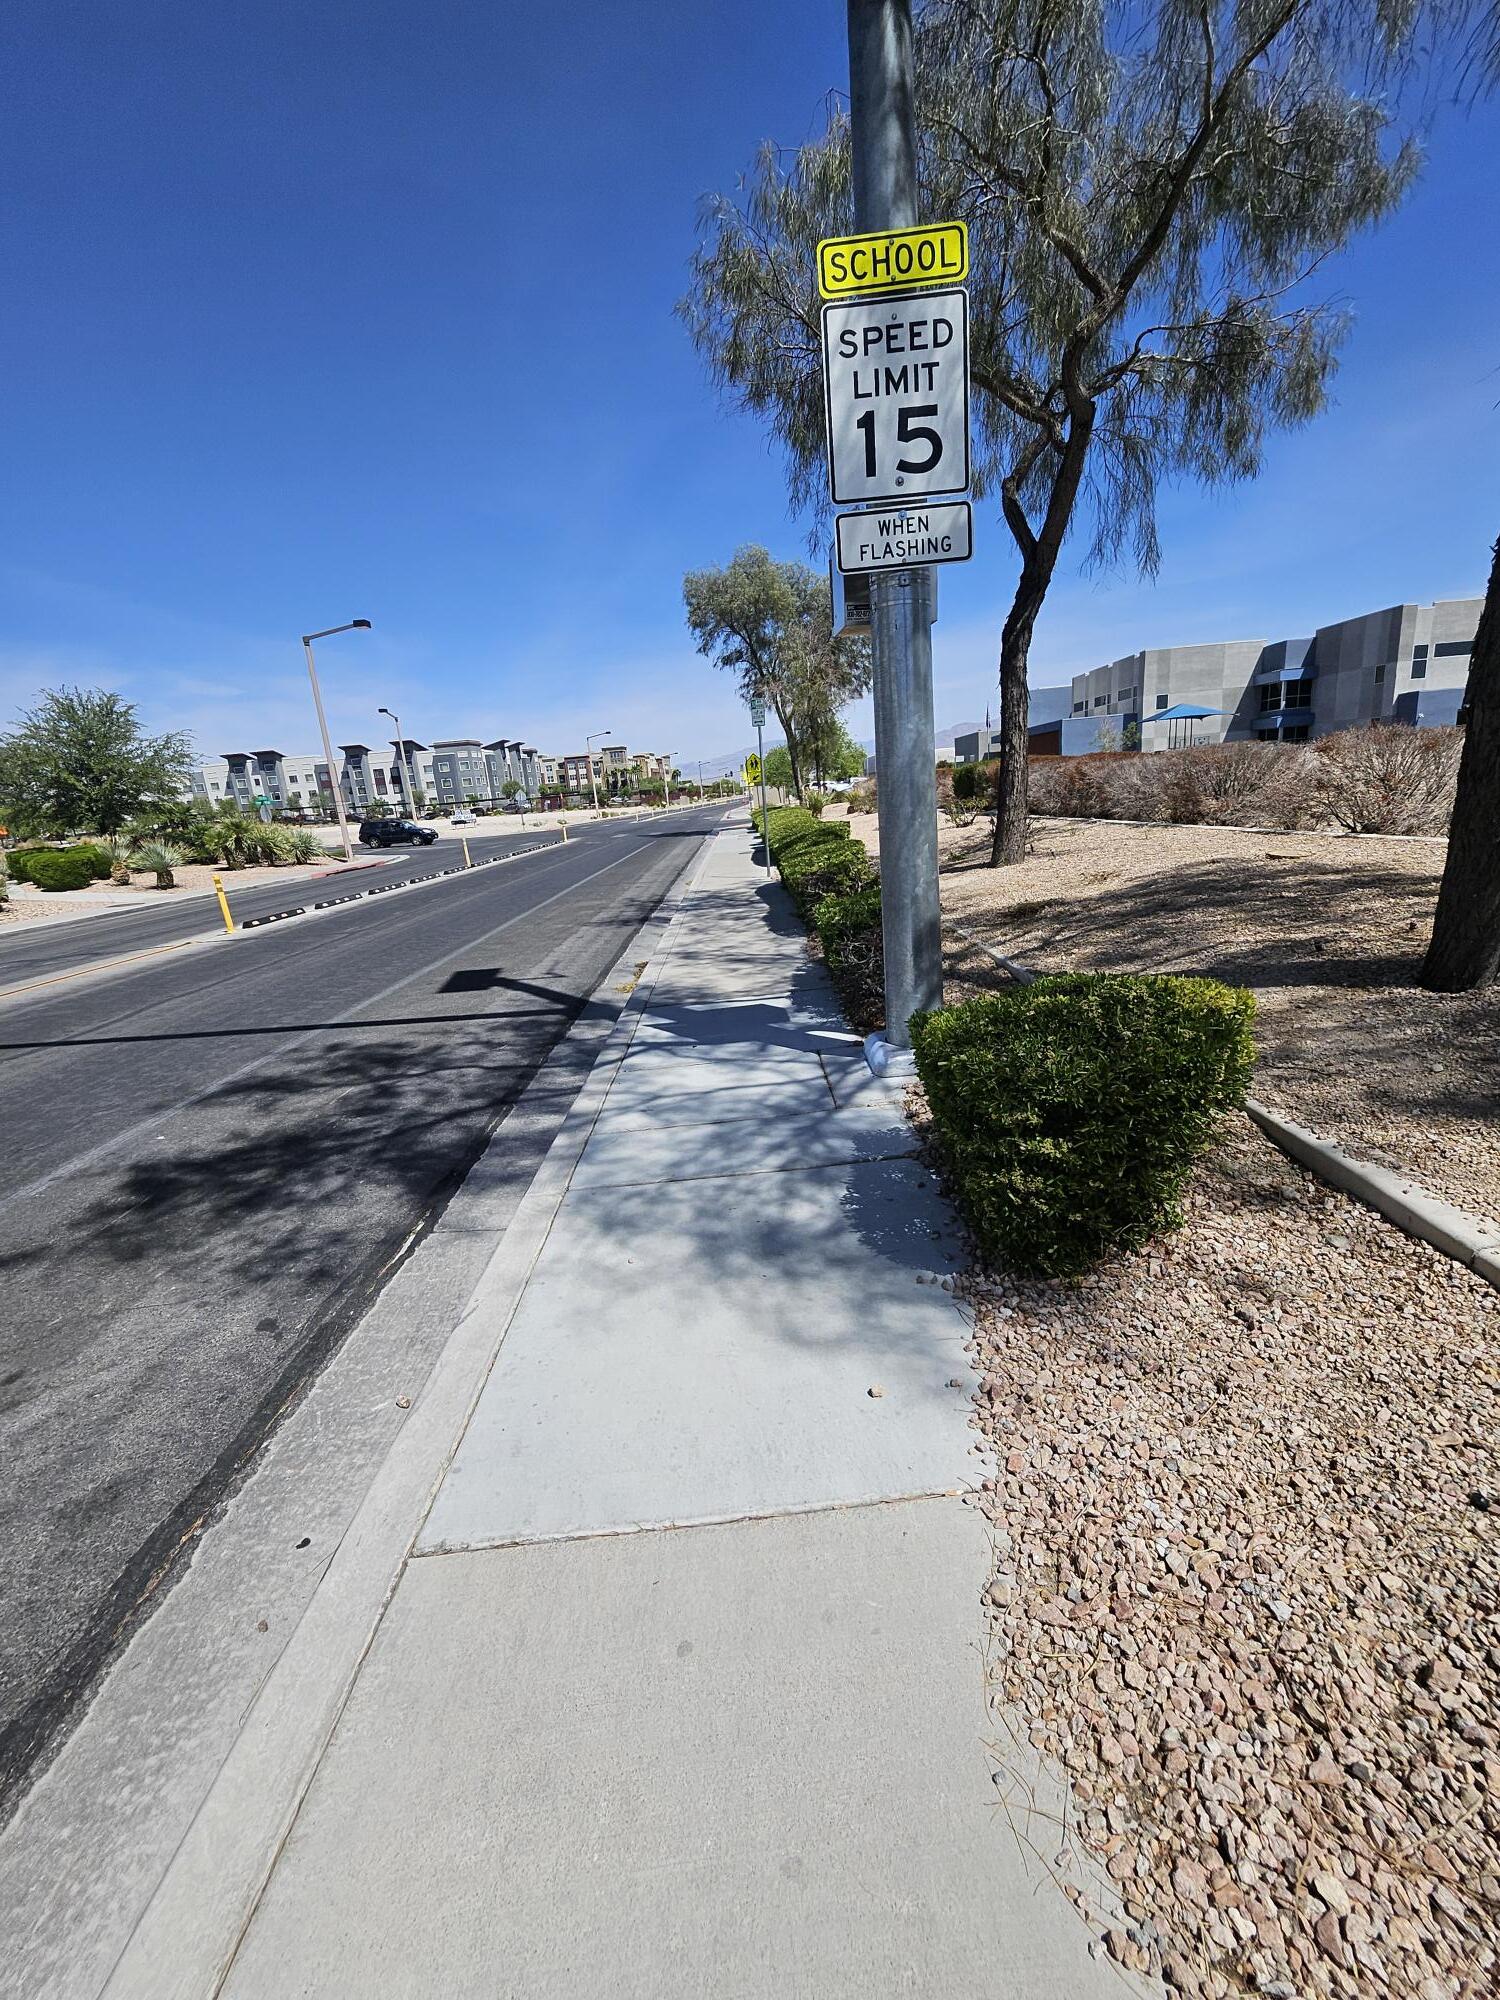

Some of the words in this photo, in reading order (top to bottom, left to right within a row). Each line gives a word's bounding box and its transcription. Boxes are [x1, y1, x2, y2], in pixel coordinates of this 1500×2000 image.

[831, 238, 957, 282] SCHOOL
[839, 318, 953, 358] SPEED
[853, 361, 939, 399] LIMIT
[856, 404, 943, 477] 15
[878, 515, 929, 537] WHEN
[860, 535, 951, 561] FLASHING
